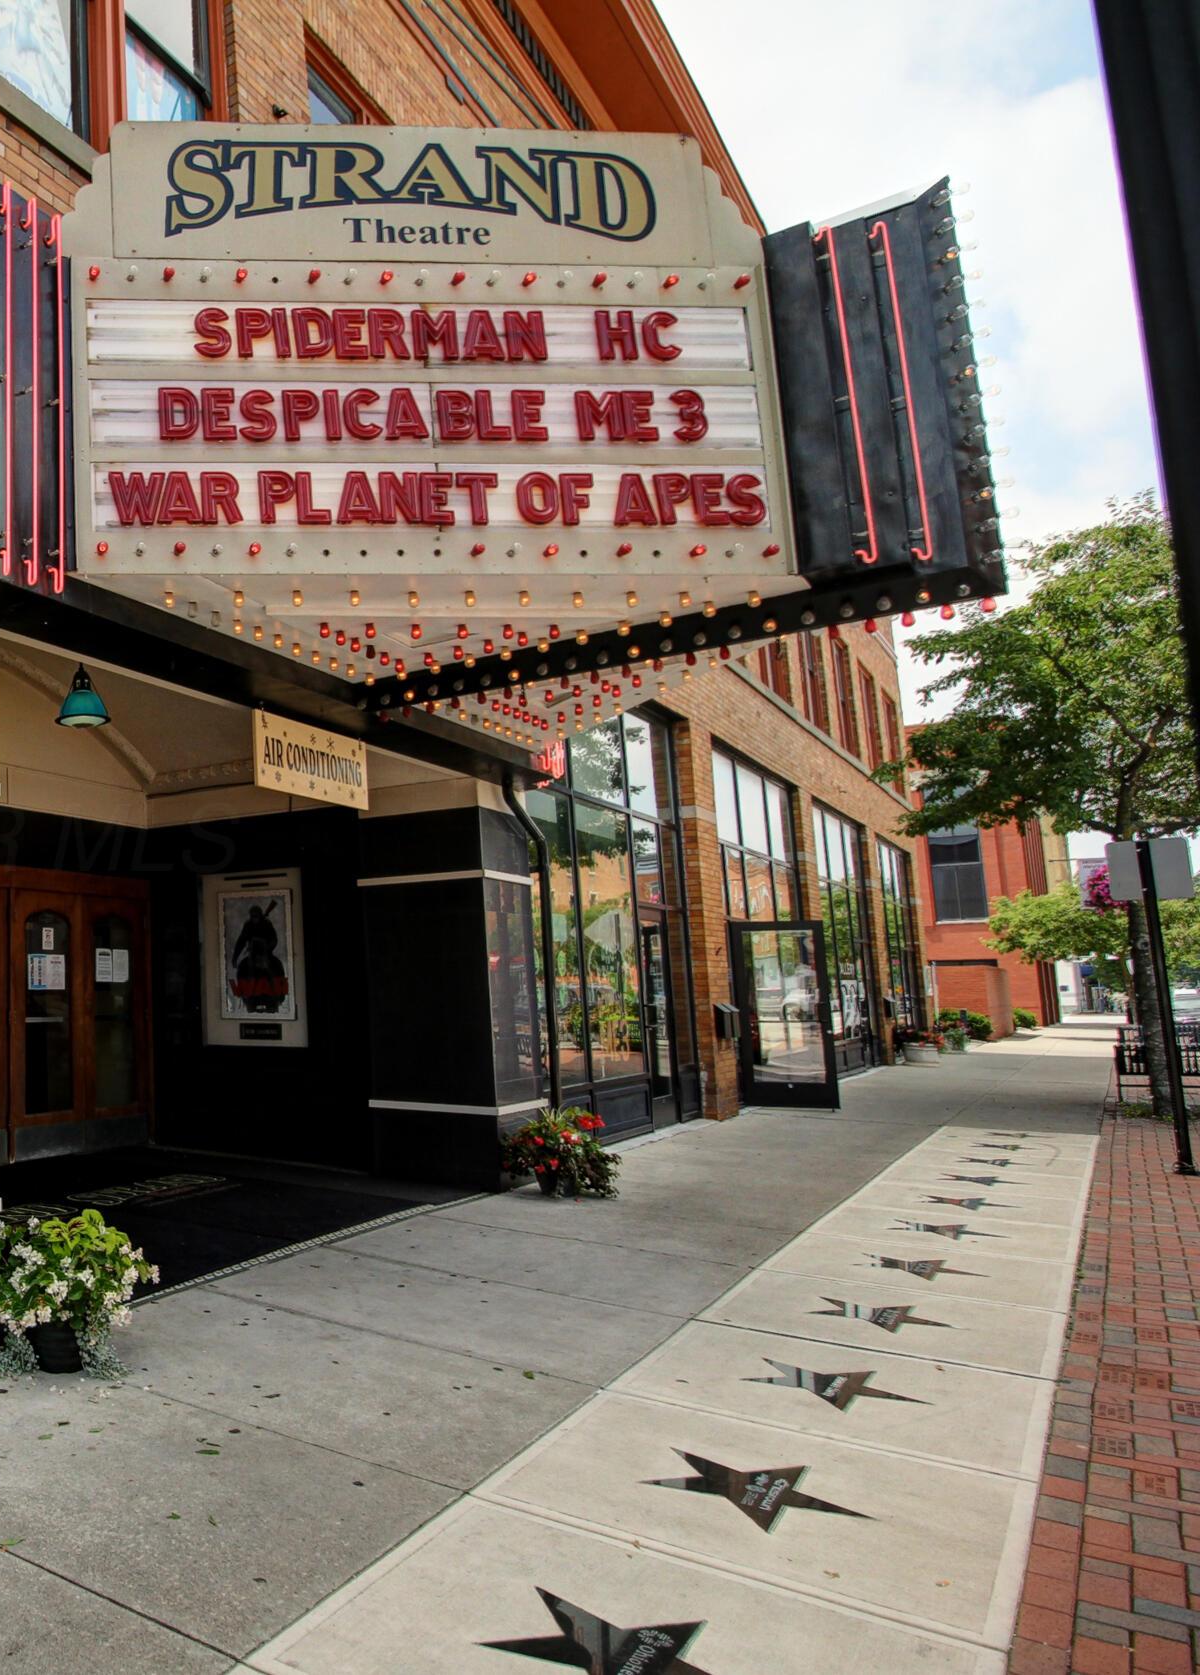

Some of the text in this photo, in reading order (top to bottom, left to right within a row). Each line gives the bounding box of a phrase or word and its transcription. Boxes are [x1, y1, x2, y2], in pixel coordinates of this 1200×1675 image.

[164, 140, 657, 242] STRAND
[342, 217, 492, 246] Theatre
[194, 307, 683, 361] SPIDERMAN HC
[157, 387, 550, 442] DESPICABLE
[108, 470, 768, 526] WAR PLANET OF APES
[263, 735, 362, 788] AIR CONDITIONING
[617, 1644, 657, 1675] OhioHe
